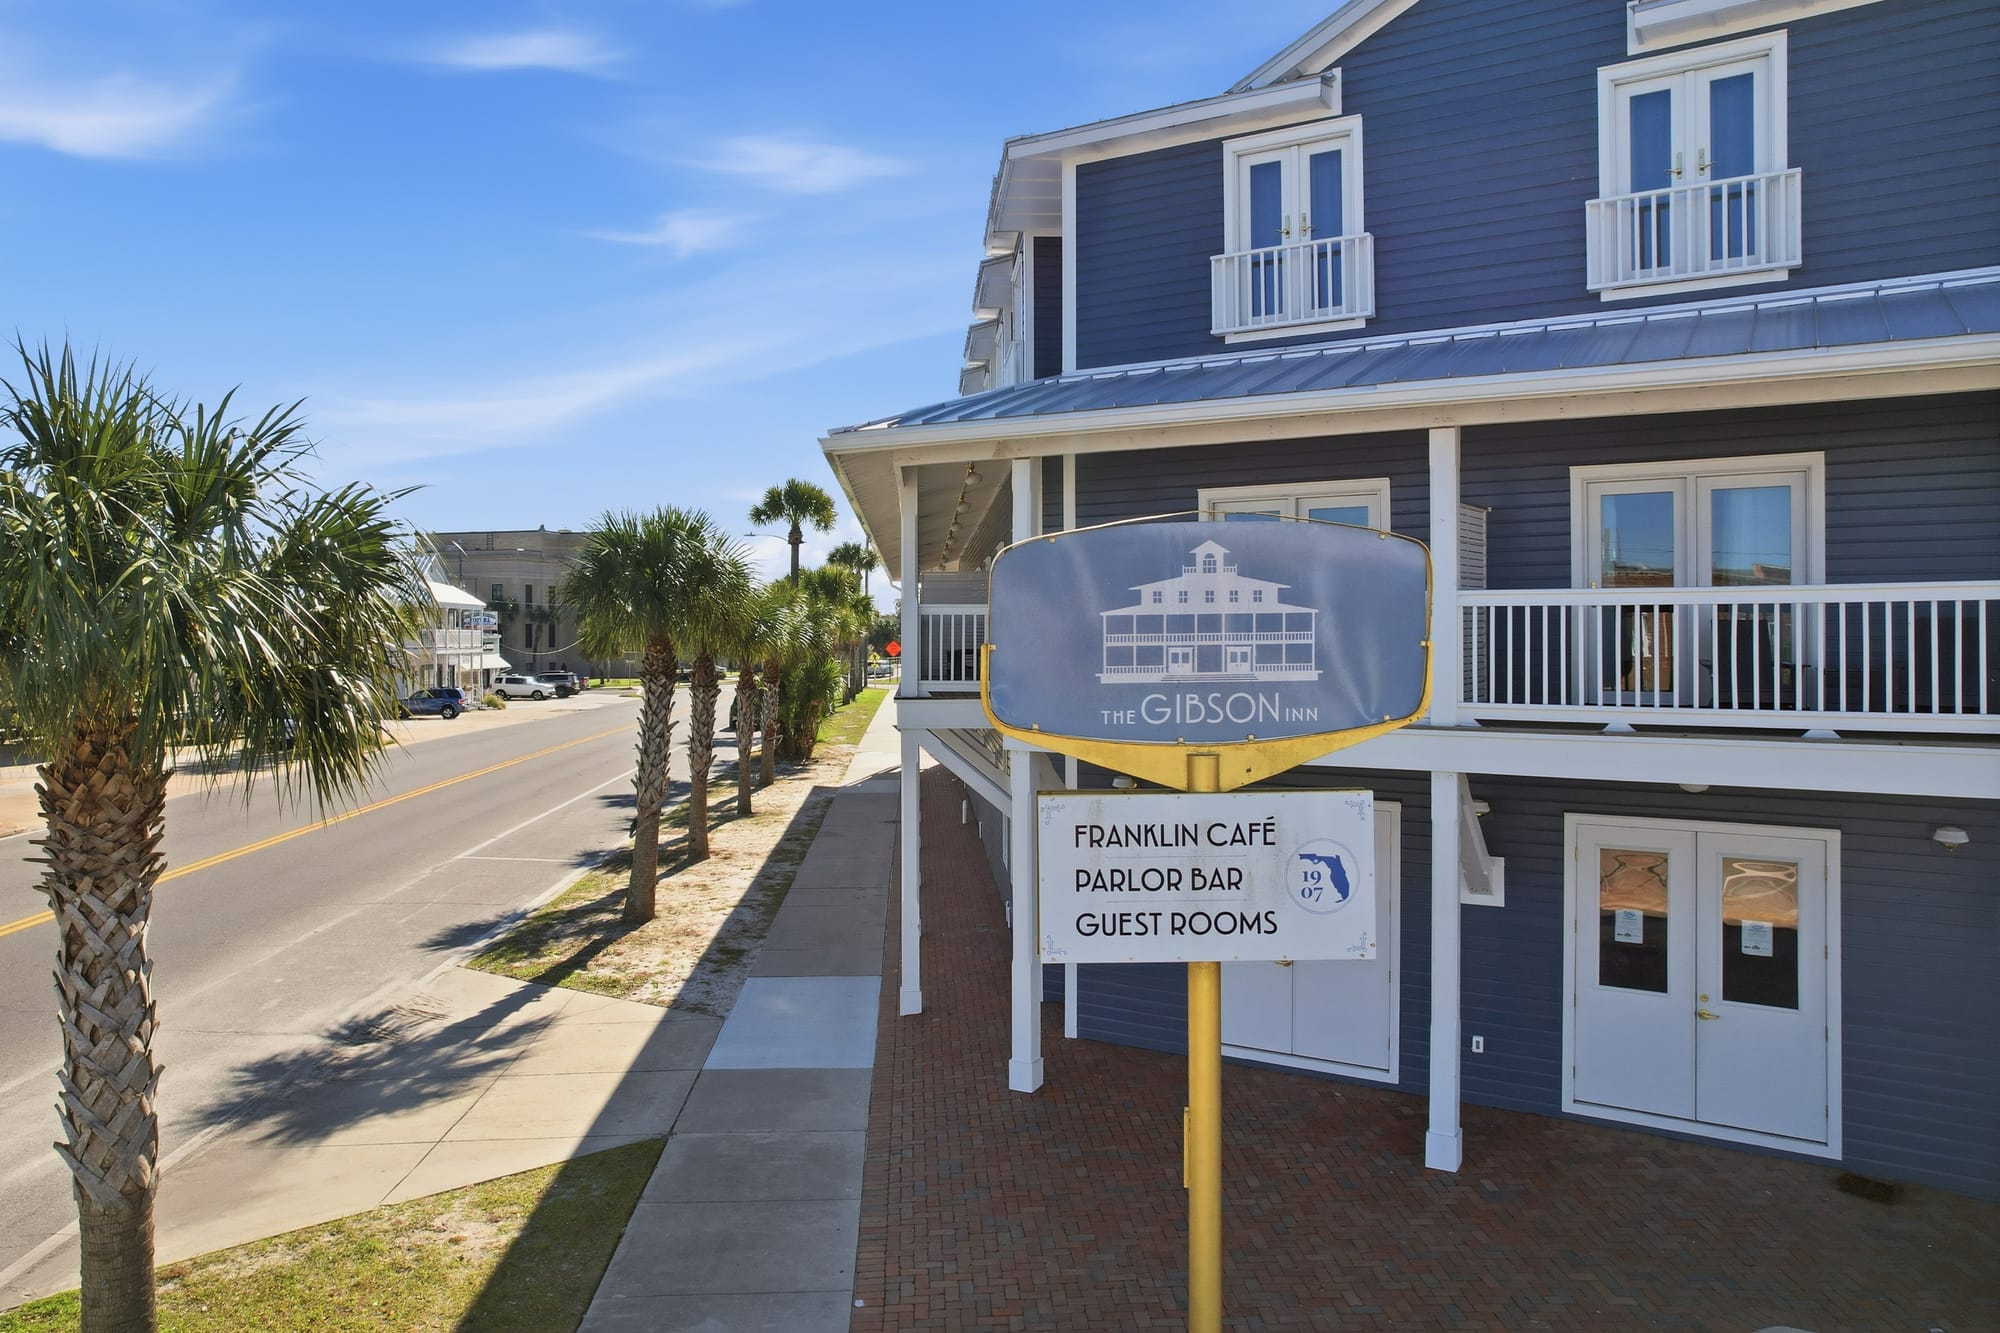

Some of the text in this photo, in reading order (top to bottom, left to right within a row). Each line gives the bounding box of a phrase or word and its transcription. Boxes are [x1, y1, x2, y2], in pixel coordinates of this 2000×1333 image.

[1101, 692, 1319, 725] THE GIBSON INN
[1075, 816, 1276, 848] FRANKLIN CAFÉ
[1075, 867, 1243, 892] PARLOR BAR
[1302, 870, 1322, 885] 19
[1300, 886, 1324, 903] 07
[1075, 910, 1278, 937] GUEST ROOMS
